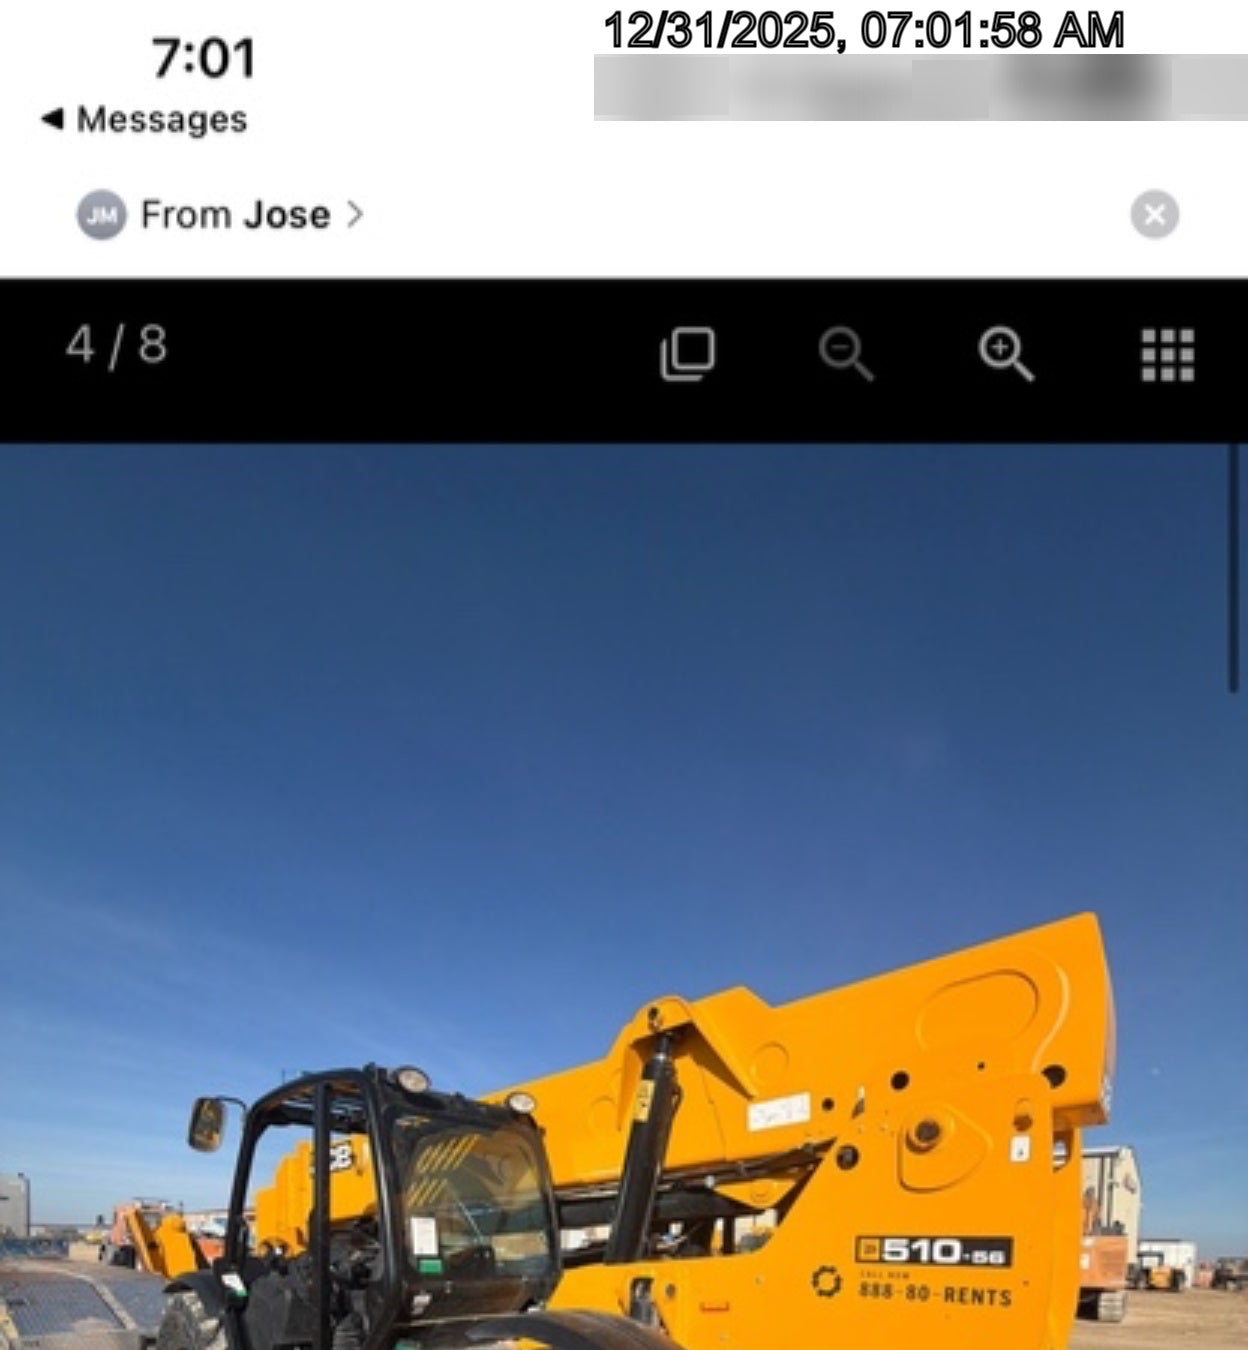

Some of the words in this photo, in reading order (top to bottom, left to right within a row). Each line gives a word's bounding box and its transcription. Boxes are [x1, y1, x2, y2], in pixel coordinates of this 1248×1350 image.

[152, 36, 254, 79] 7:01
[77, 104, 248, 138] Messages
[86, 206, 119, 226] JM
[142, 199, 232, 229] From
[243, 199, 331, 229] Jose
[65, 323, 95, 363] 4
[139, 323, 167, 363] 8
